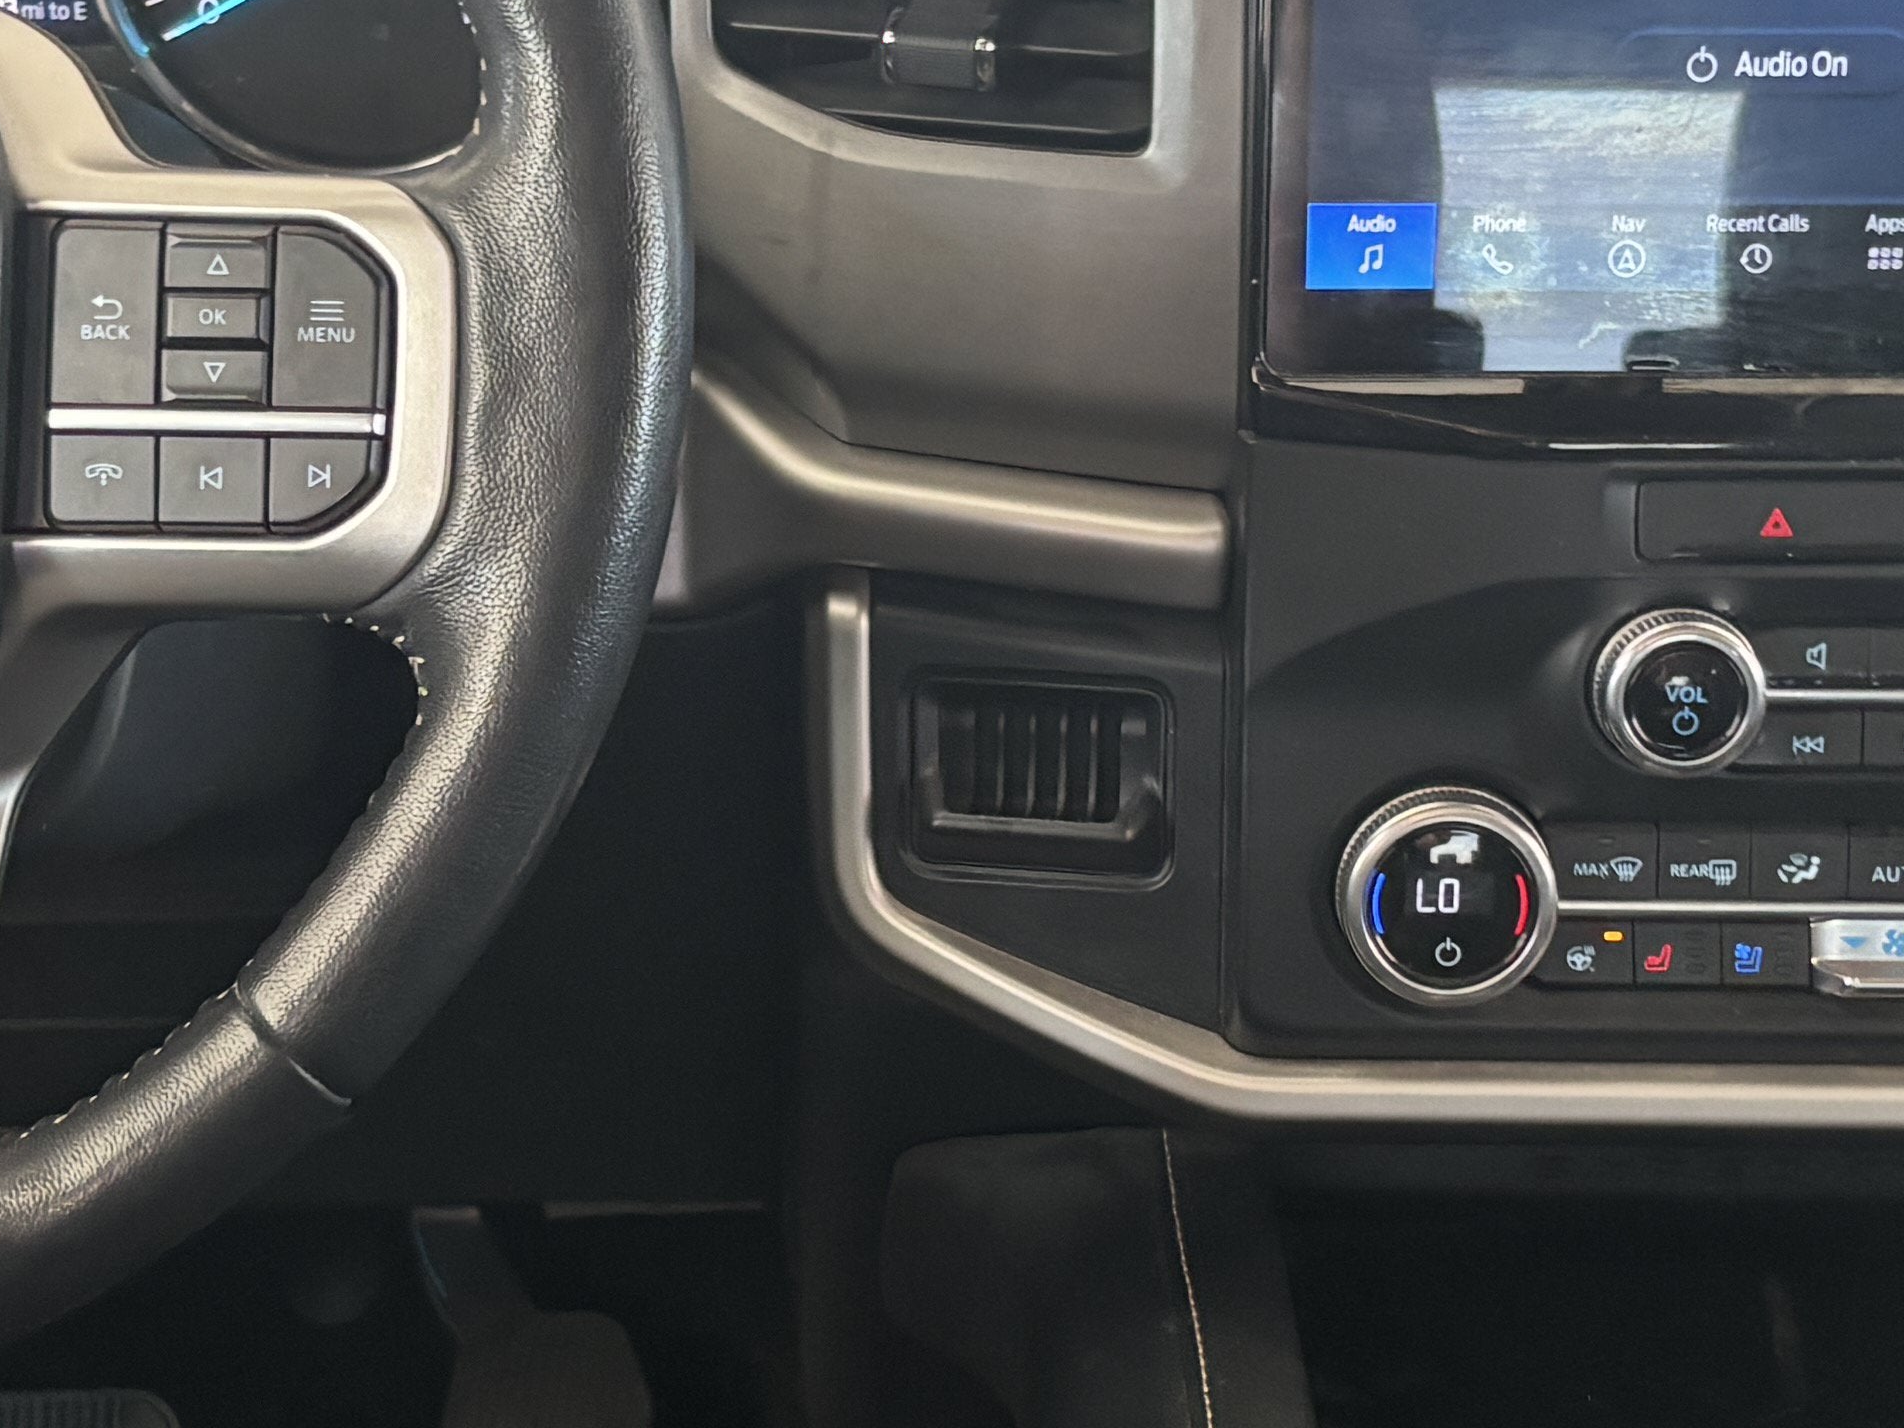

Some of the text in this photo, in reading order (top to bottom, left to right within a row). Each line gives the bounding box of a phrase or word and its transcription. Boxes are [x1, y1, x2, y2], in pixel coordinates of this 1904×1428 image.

[21, 1, 45, 21] mi
[48, 1, 71, 21] to
[73, 1, 88, 21] E
[1734, 50, 1849, 78] Audio On
[1347, 213, 1396, 233] Audio
[1472, 213, 1526, 233] Phone
[1612, 214, 1646, 233] Nav
[1706, 213, 1810, 233] Recent Calls
[198, 308, 227, 326] OK
[80, 324, 131, 341] BACK
[297, 327, 356, 343] MENU
[1664, 684, 1709, 705] VOL
[1573, 861, 1609, 878] MAX
[1670, 861, 1709, 878] REAR
[1415, 877, 1460, 914] LO
